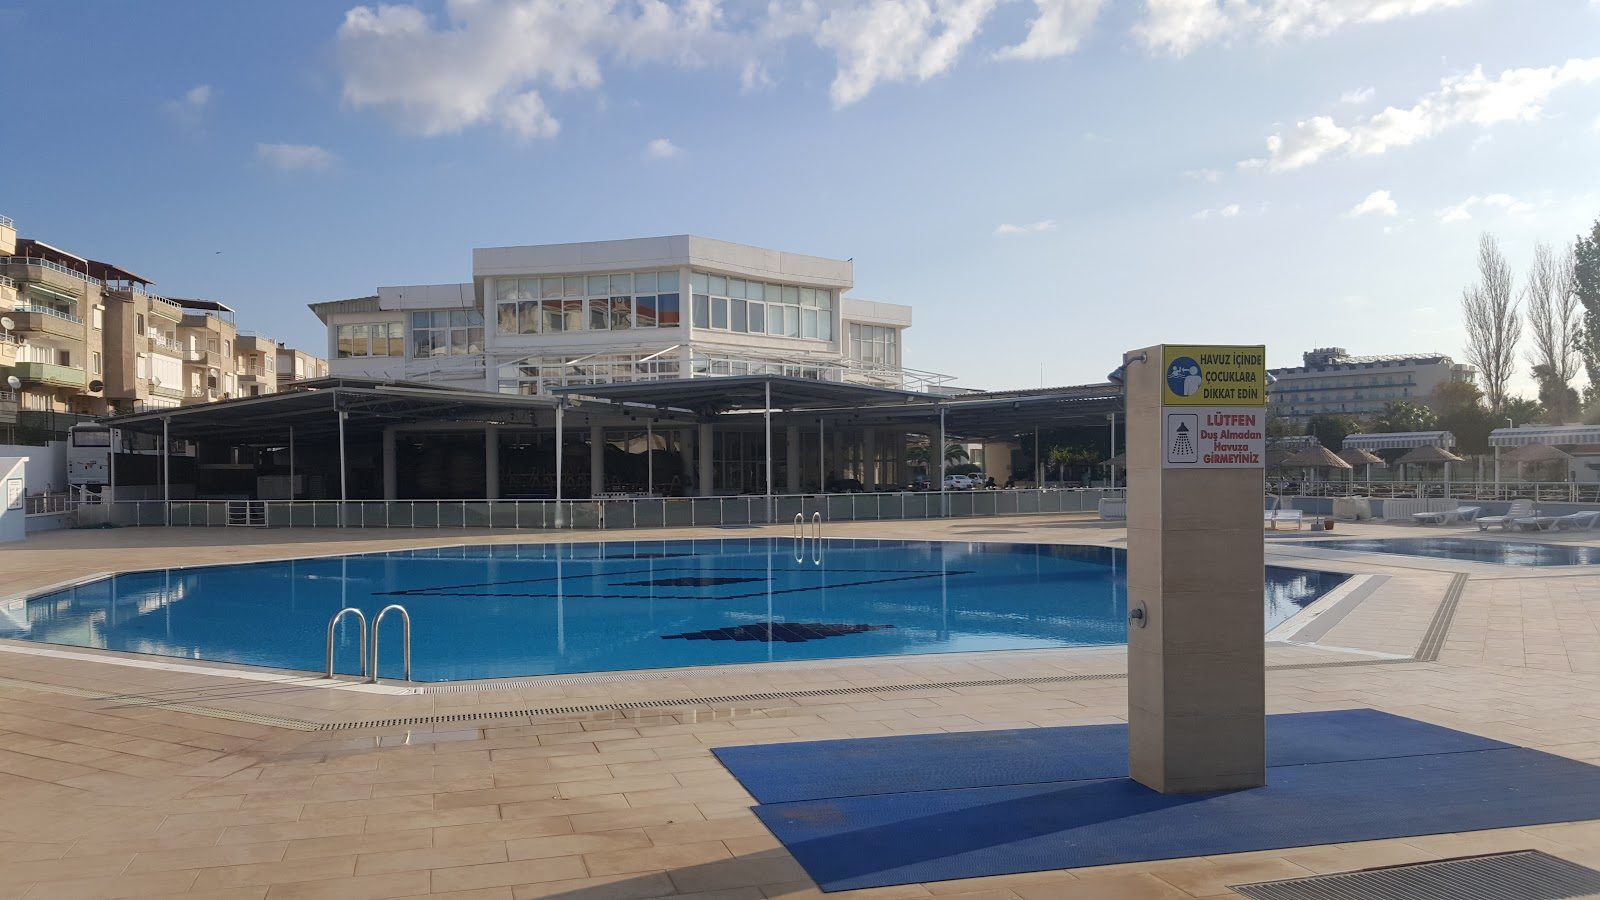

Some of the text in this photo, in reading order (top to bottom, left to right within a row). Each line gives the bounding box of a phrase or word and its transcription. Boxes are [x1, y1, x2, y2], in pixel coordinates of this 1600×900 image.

[1200, 352, 1261, 368] HAVUZ İÇİNDE
[1206, 372, 1256, 384] ÇOCUKLARA
[1204, 386, 1258, 399] DİKKAT EDİN
[1207, 412, 1256, 426] LÜTFEN
[1200, 430, 1262, 441] Duş Almadan
[1214, 442, 1248, 451] Havuza
[1204, 452, 1259, 464] GİRMEYİNİZ
